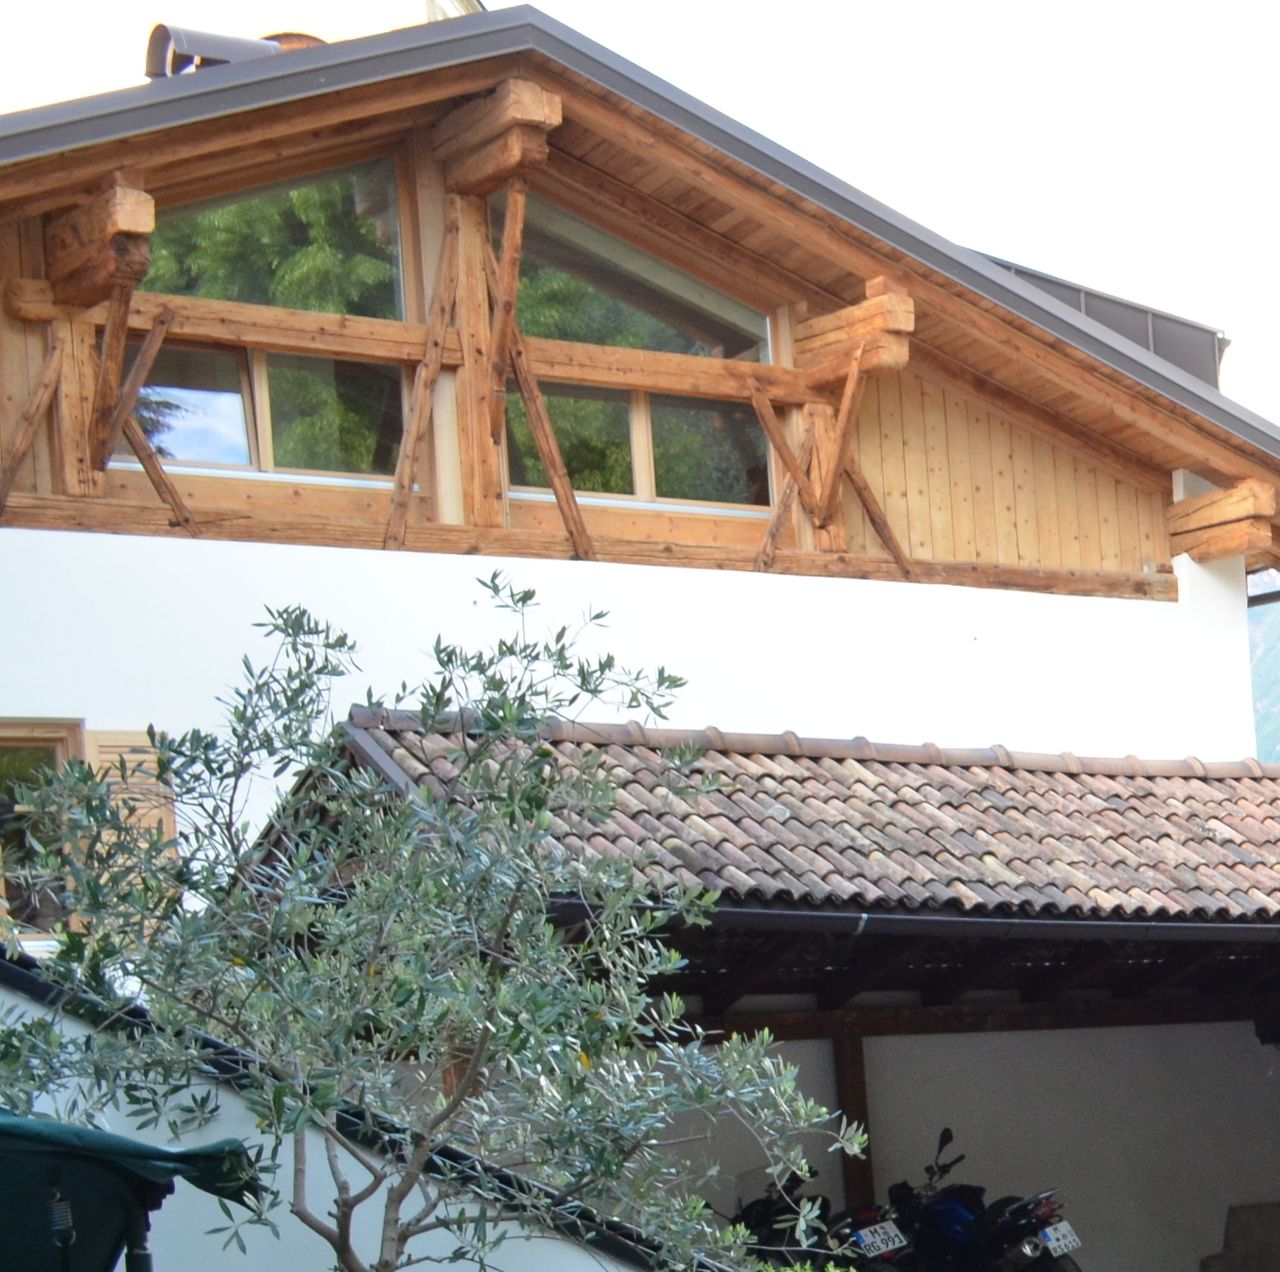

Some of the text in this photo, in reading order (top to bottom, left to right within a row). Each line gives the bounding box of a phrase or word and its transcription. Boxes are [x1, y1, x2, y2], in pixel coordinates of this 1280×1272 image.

[869, 1227, 881, 1239] M
[864, 1233, 904, 1255] RG 991
